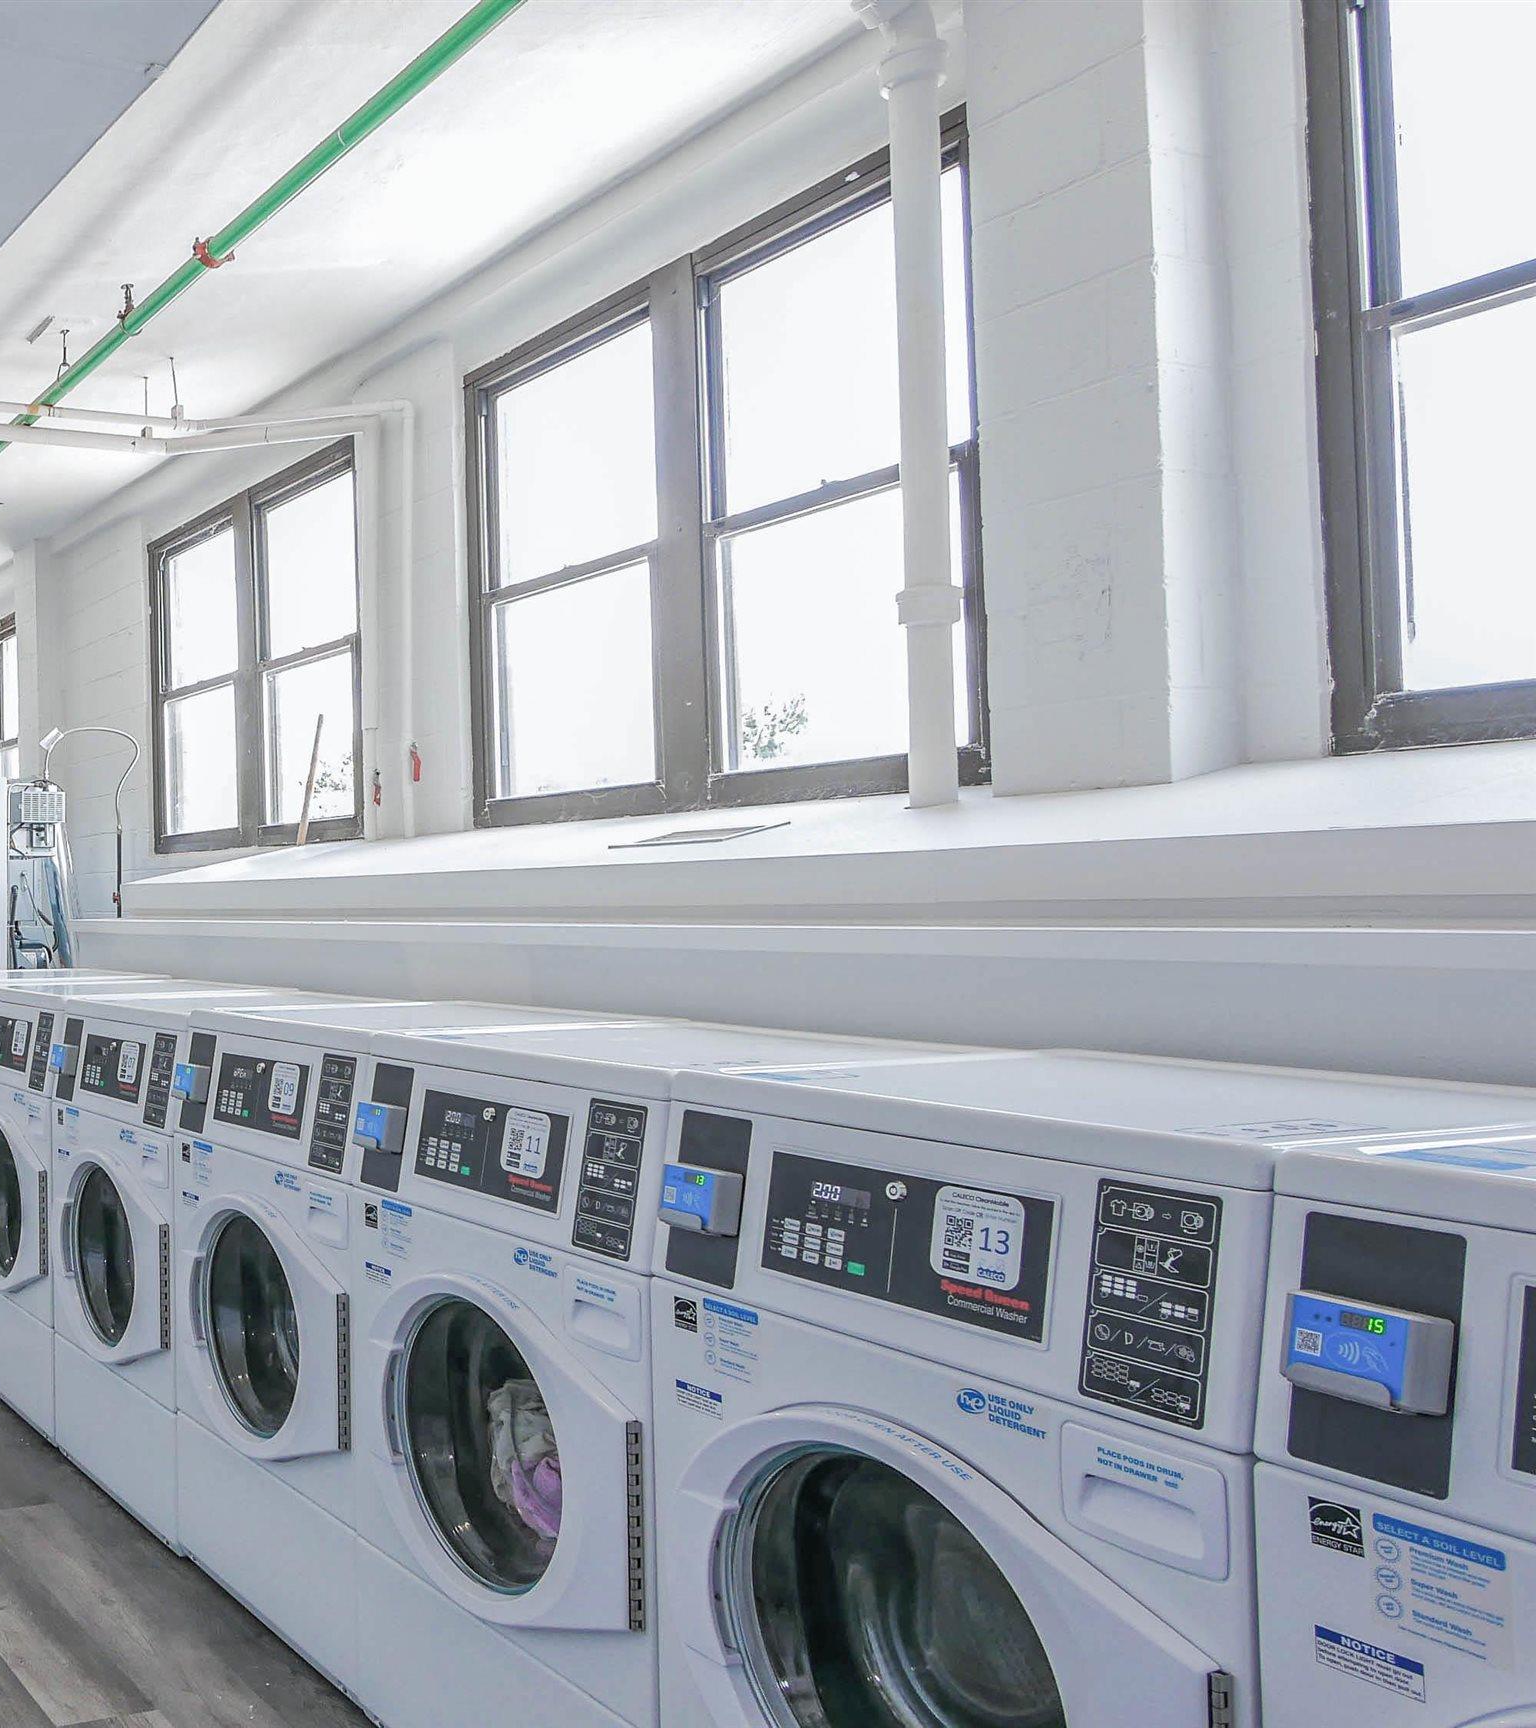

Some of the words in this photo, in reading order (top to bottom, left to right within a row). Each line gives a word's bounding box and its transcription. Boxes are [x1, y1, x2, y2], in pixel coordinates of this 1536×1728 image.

[525, 1136, 541, 1155] 11
[696, 1175, 705, 1185] 13
[813, 1182, 840, 1201] 2.00
[979, 1227, 1009, 1255] 13
[940, 1279, 983, 1299] Speed
[985, 1290, 1030, 1311] Queen
[947, 1294, 994, 1316] Commercial
[995, 1307, 1028, 1324] Washer
[1368, 1318, 1384, 1334] 15
[687, 1385, 711, 1397] NOTICE
[988, 1394, 1007, 1406] USE
[1009, 1401, 1034, 1414] ONLY
[988, 1404, 1021, 1420] LIQUID
[988, 1414, 1047, 1439] DETERGENT
[895, 1433, 942, 1462] AFTER
[942, 1460, 973, 1481] USE
[1097, 1447, 1122, 1459] PLACE
[1123, 1455, 1144, 1467] PODS
[1146, 1462, 1155, 1471] IN
[1097, 1458, 1113, 1467] NOT
[1114, 1463, 1123, 1471] IN
[1124, 1466, 1158, 1482] DRAWER
[1313, 1536, 1341, 1549] ENERGY
[1343, 1543, 1363, 1556] STAR
[1377, 1521, 1418, 1540] SELECT
[1421, 1535, 1431, 1545] A
[1433, 1539, 1460, 1553] SOIL
[1463, 1548, 1502, 1567] LEVEL
[1409, 1546, 1444, 1561] Premium
[1445, 1557, 1468, 1571] Wash
[1410, 1578, 1434, 1591] Super
[1435, 1587, 1458, 1599] Wash
[1412, 1609, 1448, 1627] Standard
[1449, 1622, 1472, 1636] Wash
[1317, 1640, 1335, 1651] DOOR
[1336, 1647, 1354, 1658] LOCK
[1356, 1653, 1375, 1665] LIGHT
[1340, 1636, 1396, 1664] NOTICE
